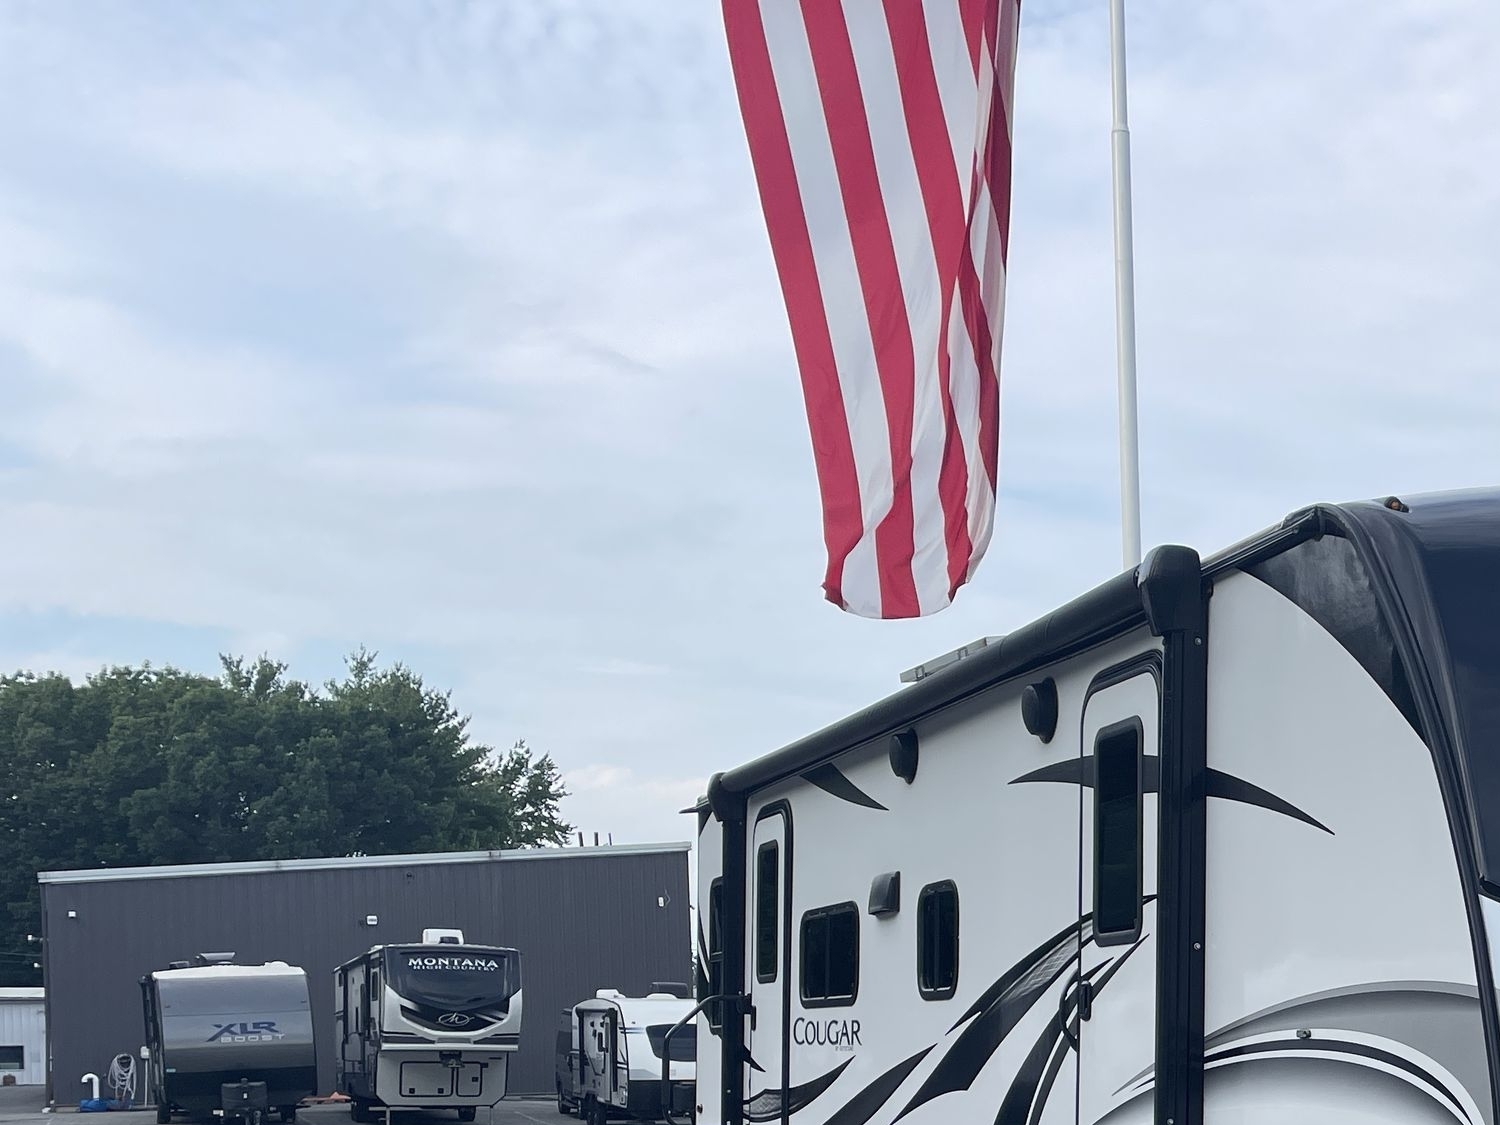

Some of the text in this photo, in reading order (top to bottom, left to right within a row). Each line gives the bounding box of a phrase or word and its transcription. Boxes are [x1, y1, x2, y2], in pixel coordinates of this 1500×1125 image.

[408, 957, 499, 969] MONTANA
[206, 1021, 280, 1043] XLR
[220, 1033, 285, 1043] BOOST
[793, 1016, 863, 1046] COUGAR
